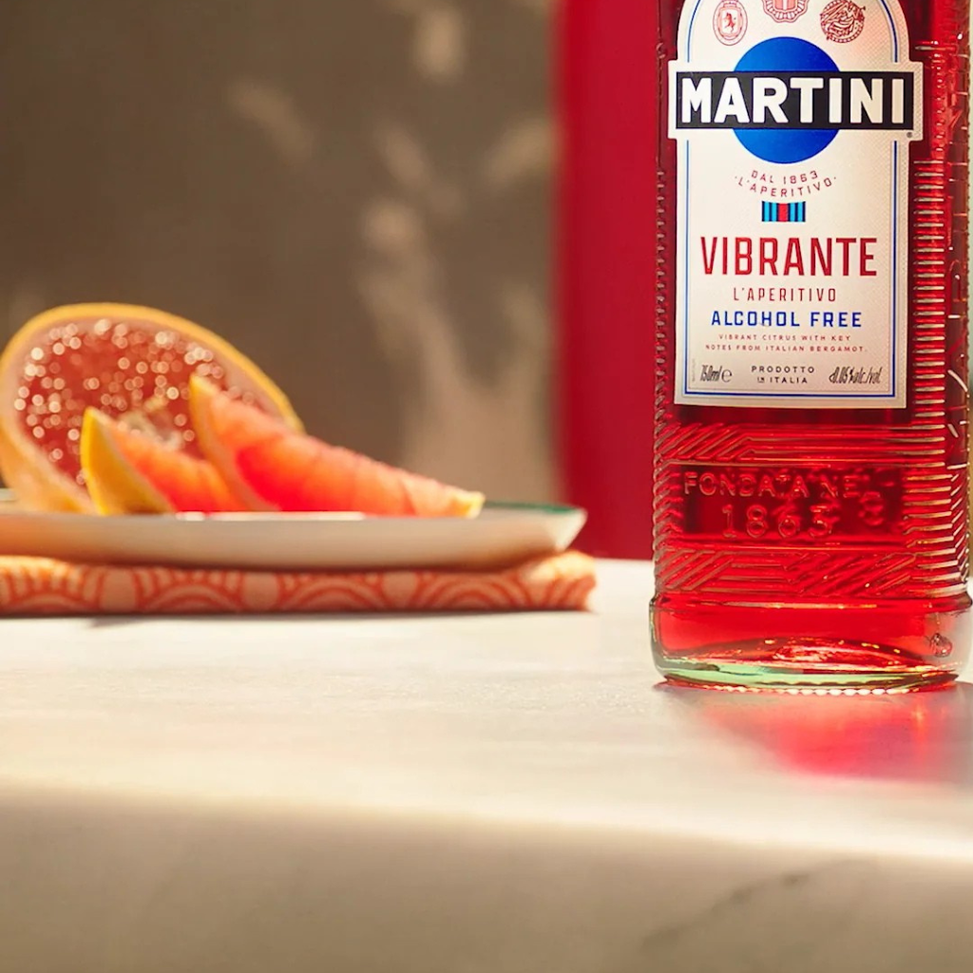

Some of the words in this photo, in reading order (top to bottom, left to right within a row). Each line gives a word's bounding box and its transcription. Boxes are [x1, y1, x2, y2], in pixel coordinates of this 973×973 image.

[681, 77, 905, 124] MARTINI
[751, 170, 774, 184] DAL
[783, 170, 819, 186] 1863
[700, 236, 878, 277] VIBRANTE
[733, 287, 837, 302] L'APERITIVO
[711, 310, 801, 327] ALCOHOL
[810, 311, 862, 327] FREE
[736, 344, 760, 352] FROM
[751, 365, 815, 374] PRODOTTO
[769, 376, 808, 384] ITALIA
